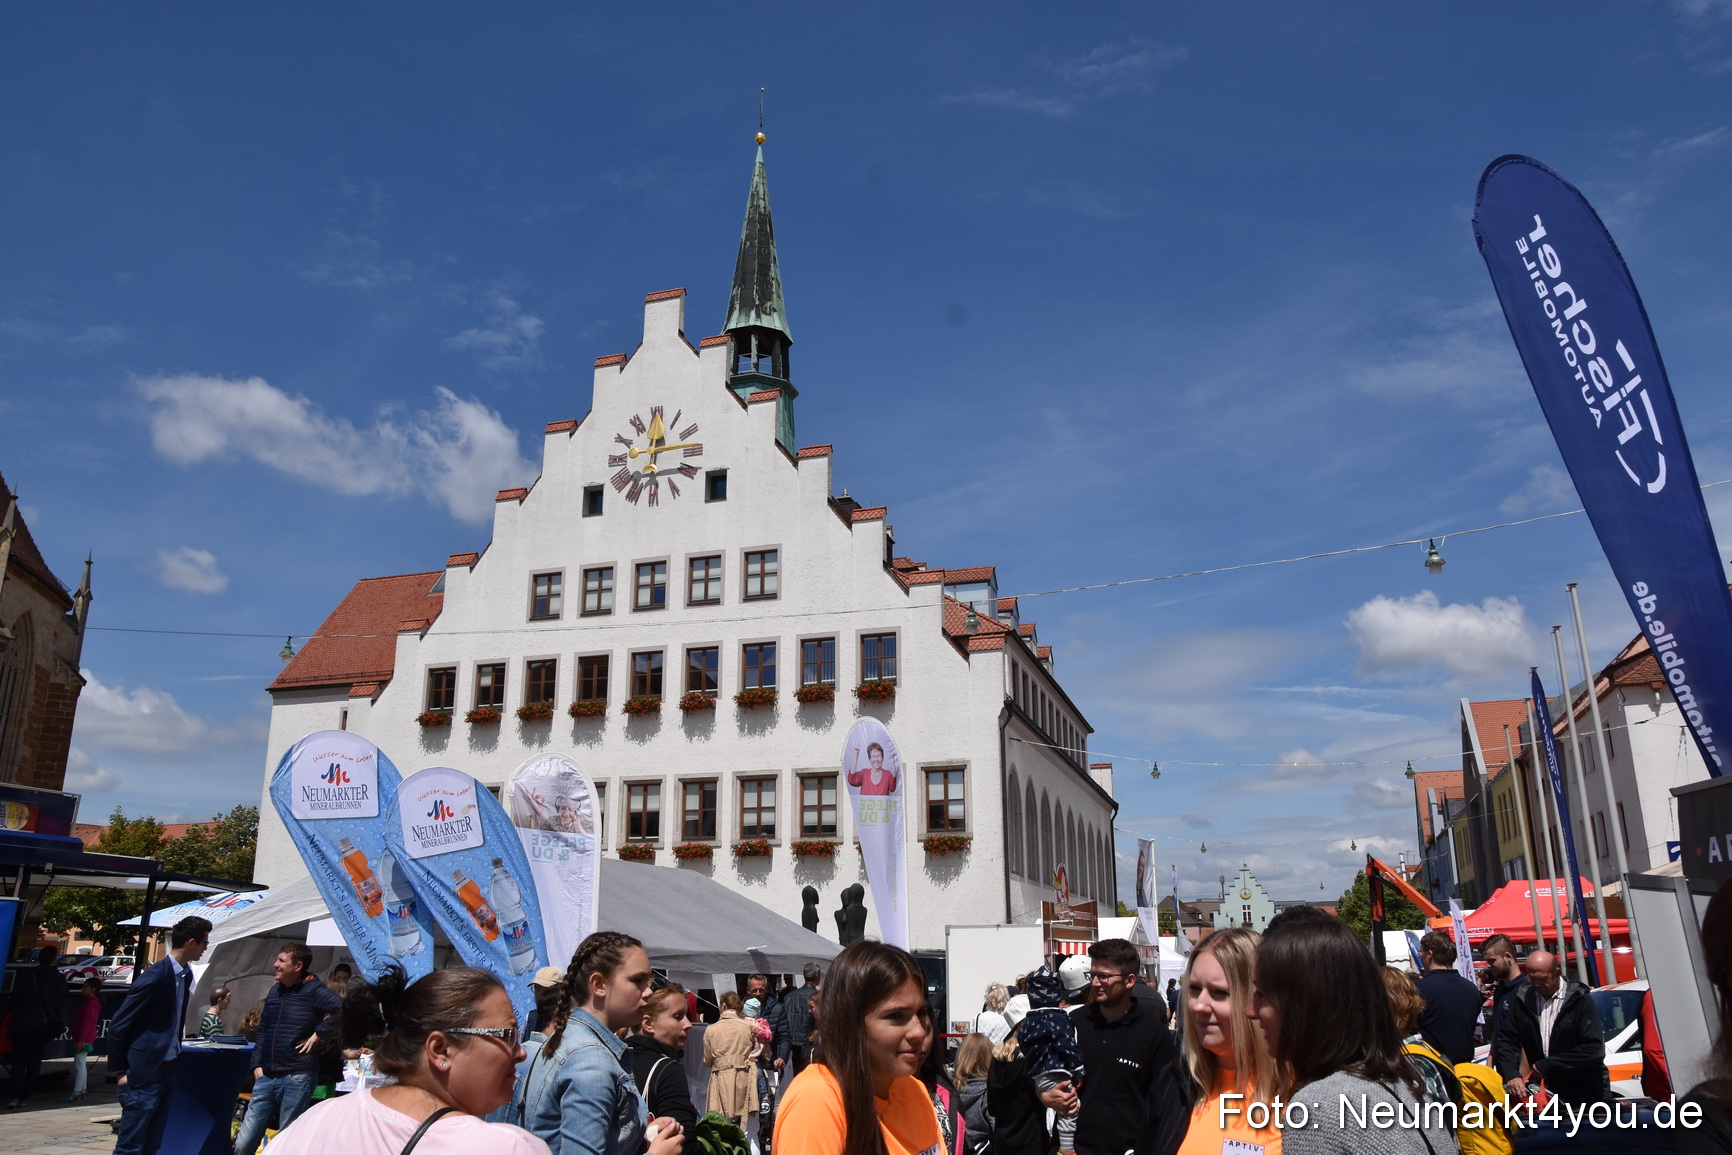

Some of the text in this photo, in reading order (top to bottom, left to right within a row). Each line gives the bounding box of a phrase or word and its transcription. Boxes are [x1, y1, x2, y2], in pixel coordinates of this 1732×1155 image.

[312, 752, 373, 763] Wasser zum Leben
[302, 784, 369, 802] NEUMARKTER
[417, 785, 472, 802] Wasser zum Leben
[309, 801, 362, 811] MINERALBRUNNEN
[411, 815, 473, 842] NEUMARKTER
[421, 833, 469, 849] MINERALBRUNNEN
[344, 903, 367, 941] ERSTER
[462, 932, 487, 965] ERSTER
[1118, 1057, 1141, 1069] APTIV
[1228, 1139, 1261, 1152] APTIV
